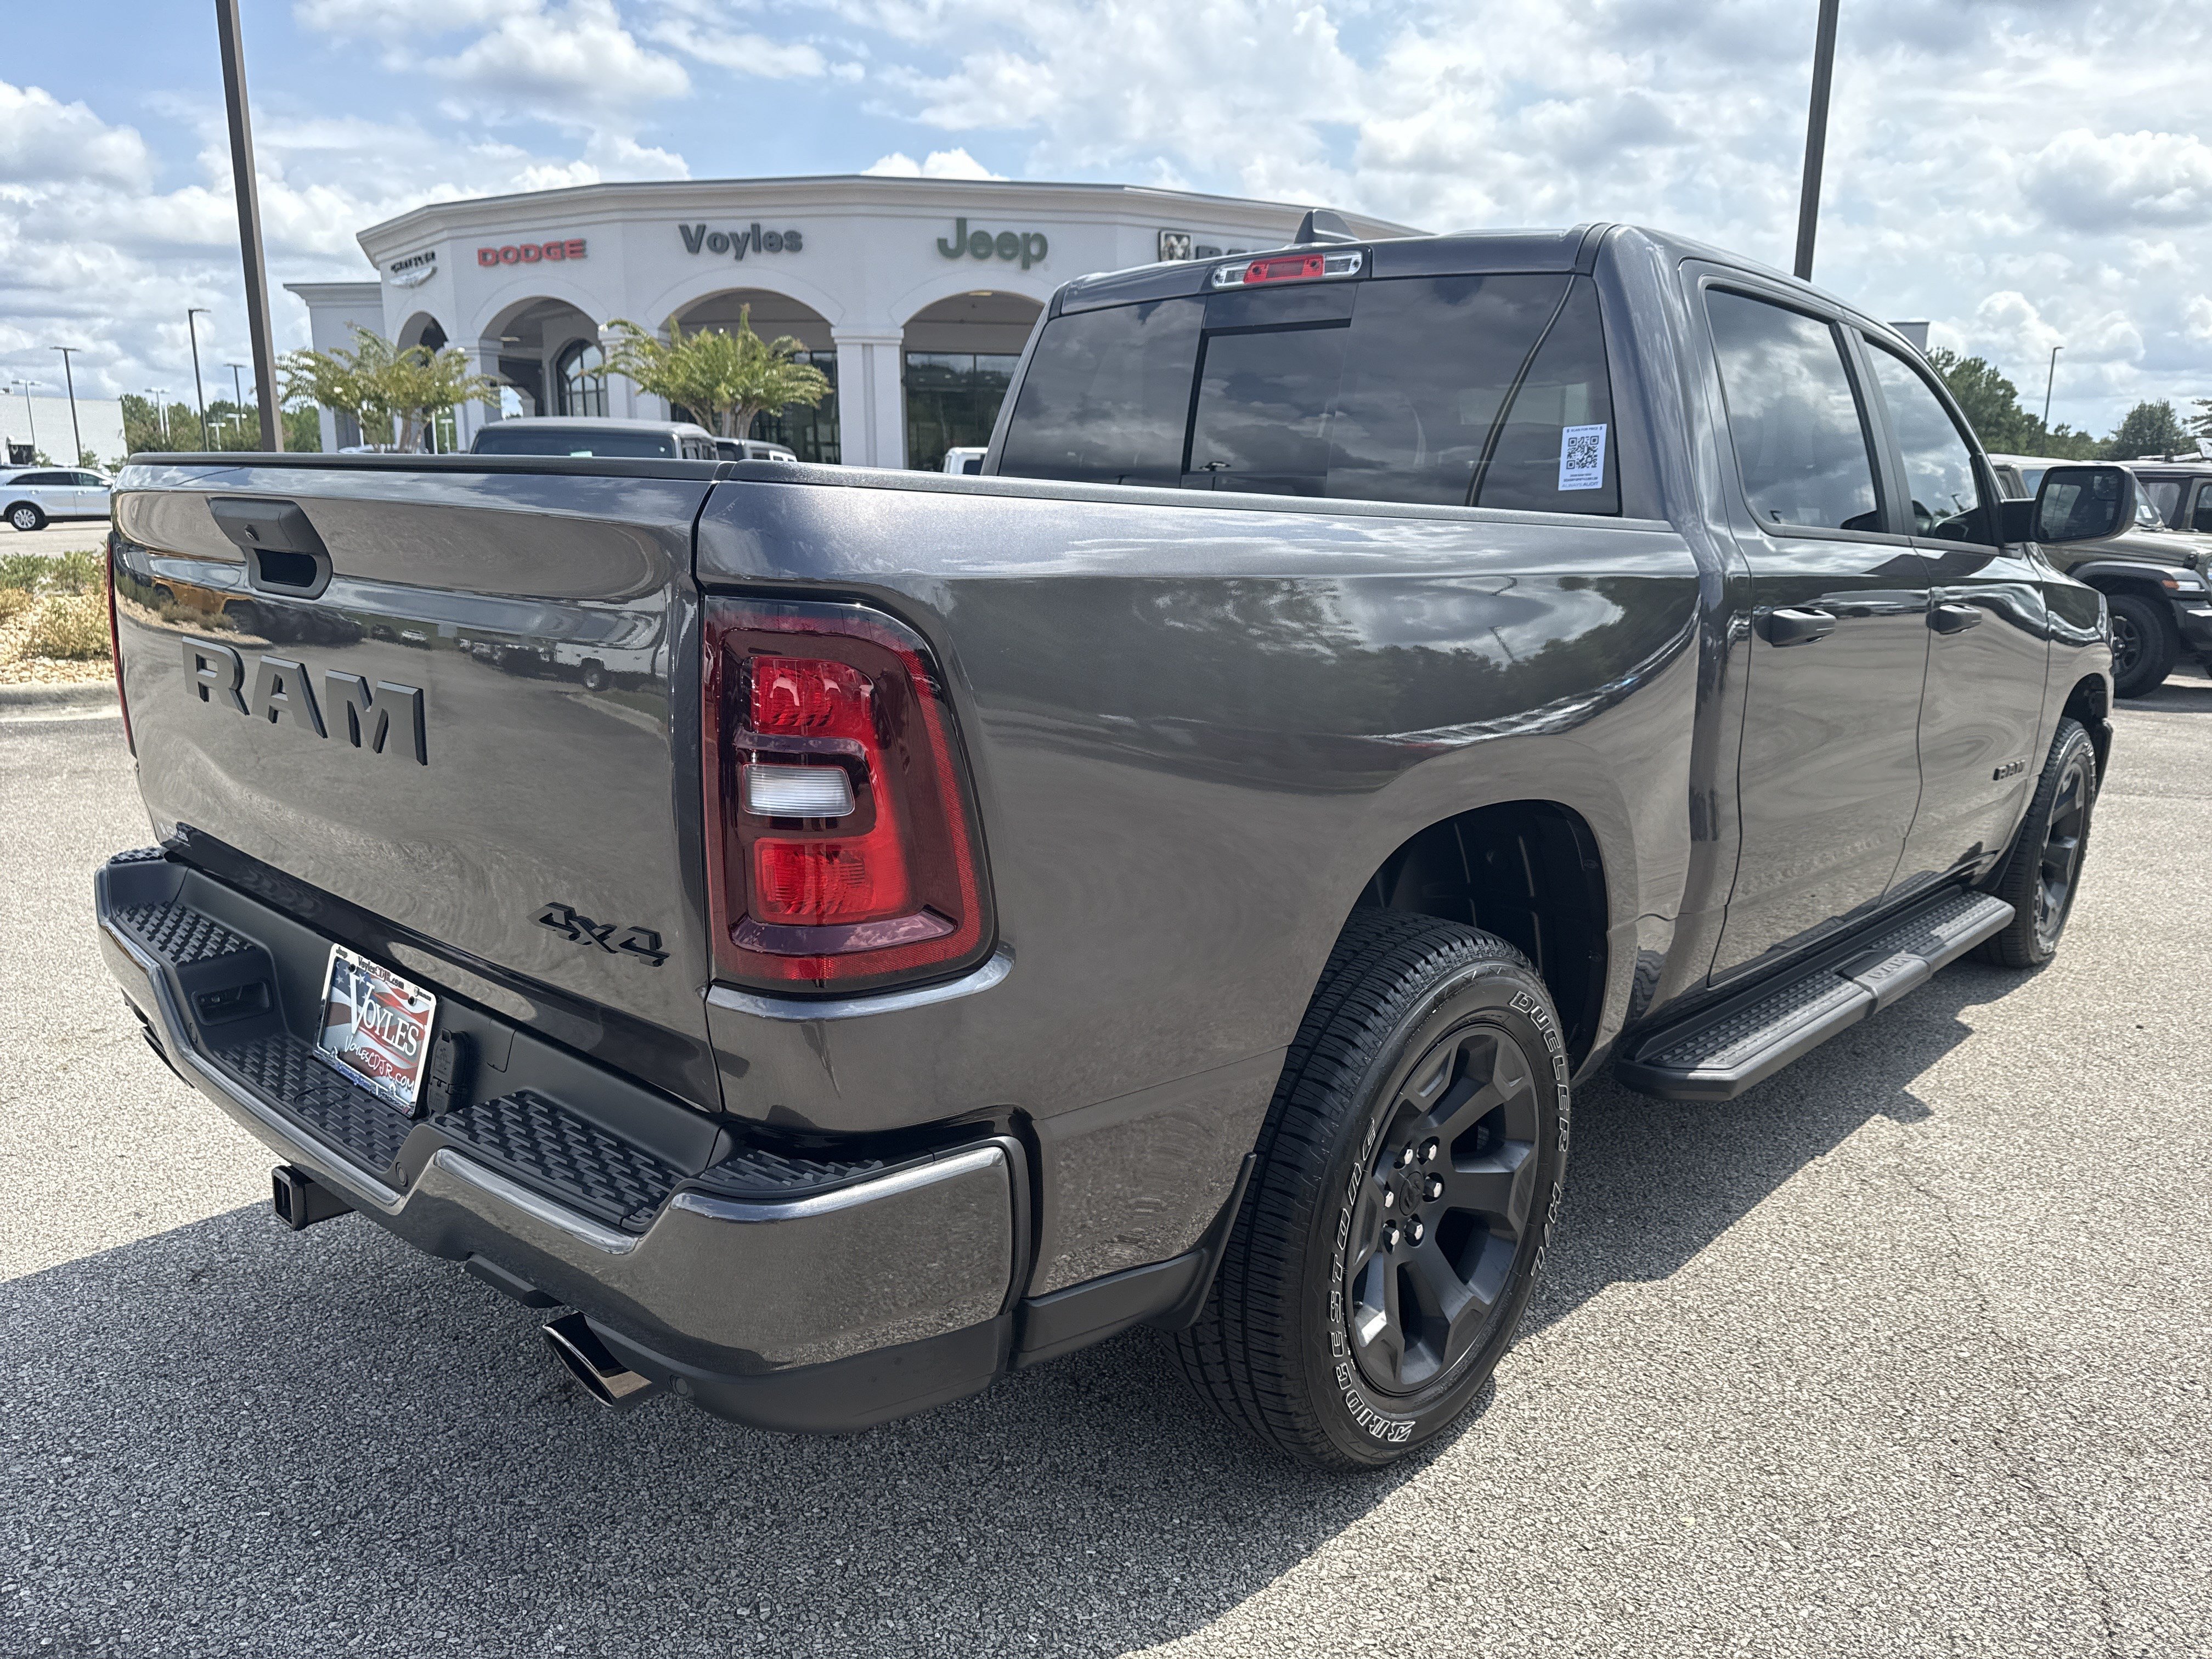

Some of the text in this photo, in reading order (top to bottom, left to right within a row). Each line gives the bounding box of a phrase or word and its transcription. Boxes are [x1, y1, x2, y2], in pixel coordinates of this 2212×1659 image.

[477, 238, 586, 267] DODGE
[678, 222, 803, 261] Voyles
[936, 217, 1048, 269] Jeep
[182, 636, 428, 766] RAM
[348, 971, 420, 1057] VOYLES
[1508, 990, 1571, 1153] DUELER
[1327, 1117, 1416, 1443] BRIDGESTONE
